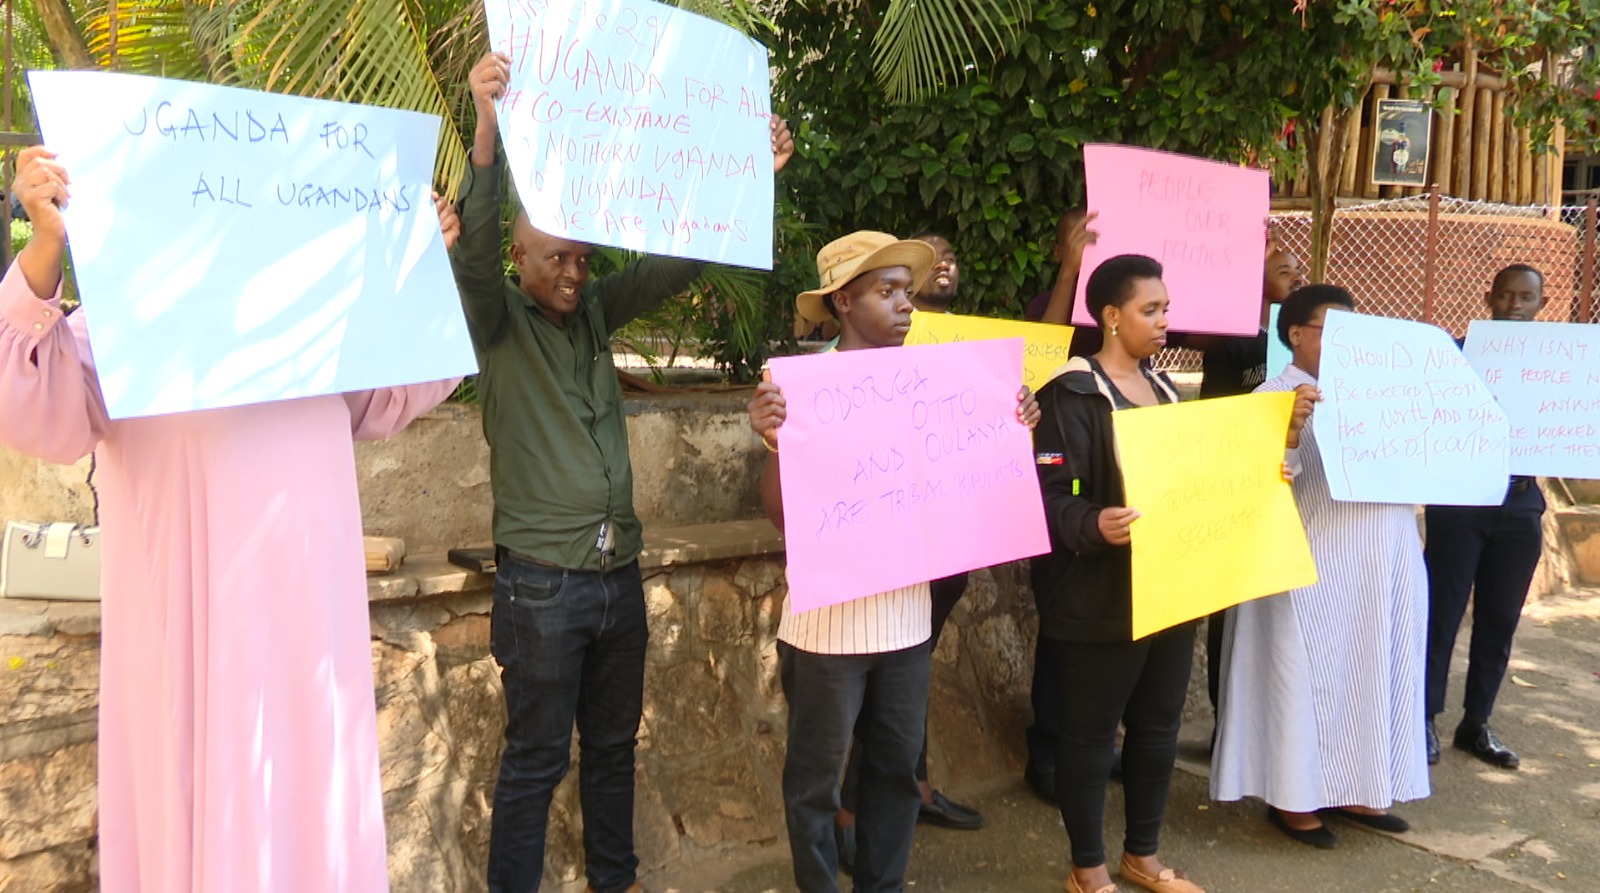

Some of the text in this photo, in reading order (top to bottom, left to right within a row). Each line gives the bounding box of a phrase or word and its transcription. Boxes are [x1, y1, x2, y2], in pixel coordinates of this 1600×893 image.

[684, 77, 729, 112] FOR
[123, 100, 375, 160] UGANDA FOR
[192, 170, 411, 213] ALL UGANDANS
[1139, 169, 1215, 206] PEOPLE
[1186, 207, 1232, 237] OVER
[1162, 238, 1232, 269] POLITICS
[1480, 335, 1529, 359] WHY
[1485, 368, 1503, 384] OF
[1521, 368, 1573, 385] PEOPLE
[912, 388, 977, 431] OTTO
[1537, 424, 1596, 440] WORKED
[853, 447, 906, 485] AND
[1510, 443, 1556, 458] WHAT
[816, 500, 869, 540] ARE
[879, 480, 949, 516] TRIBAL
